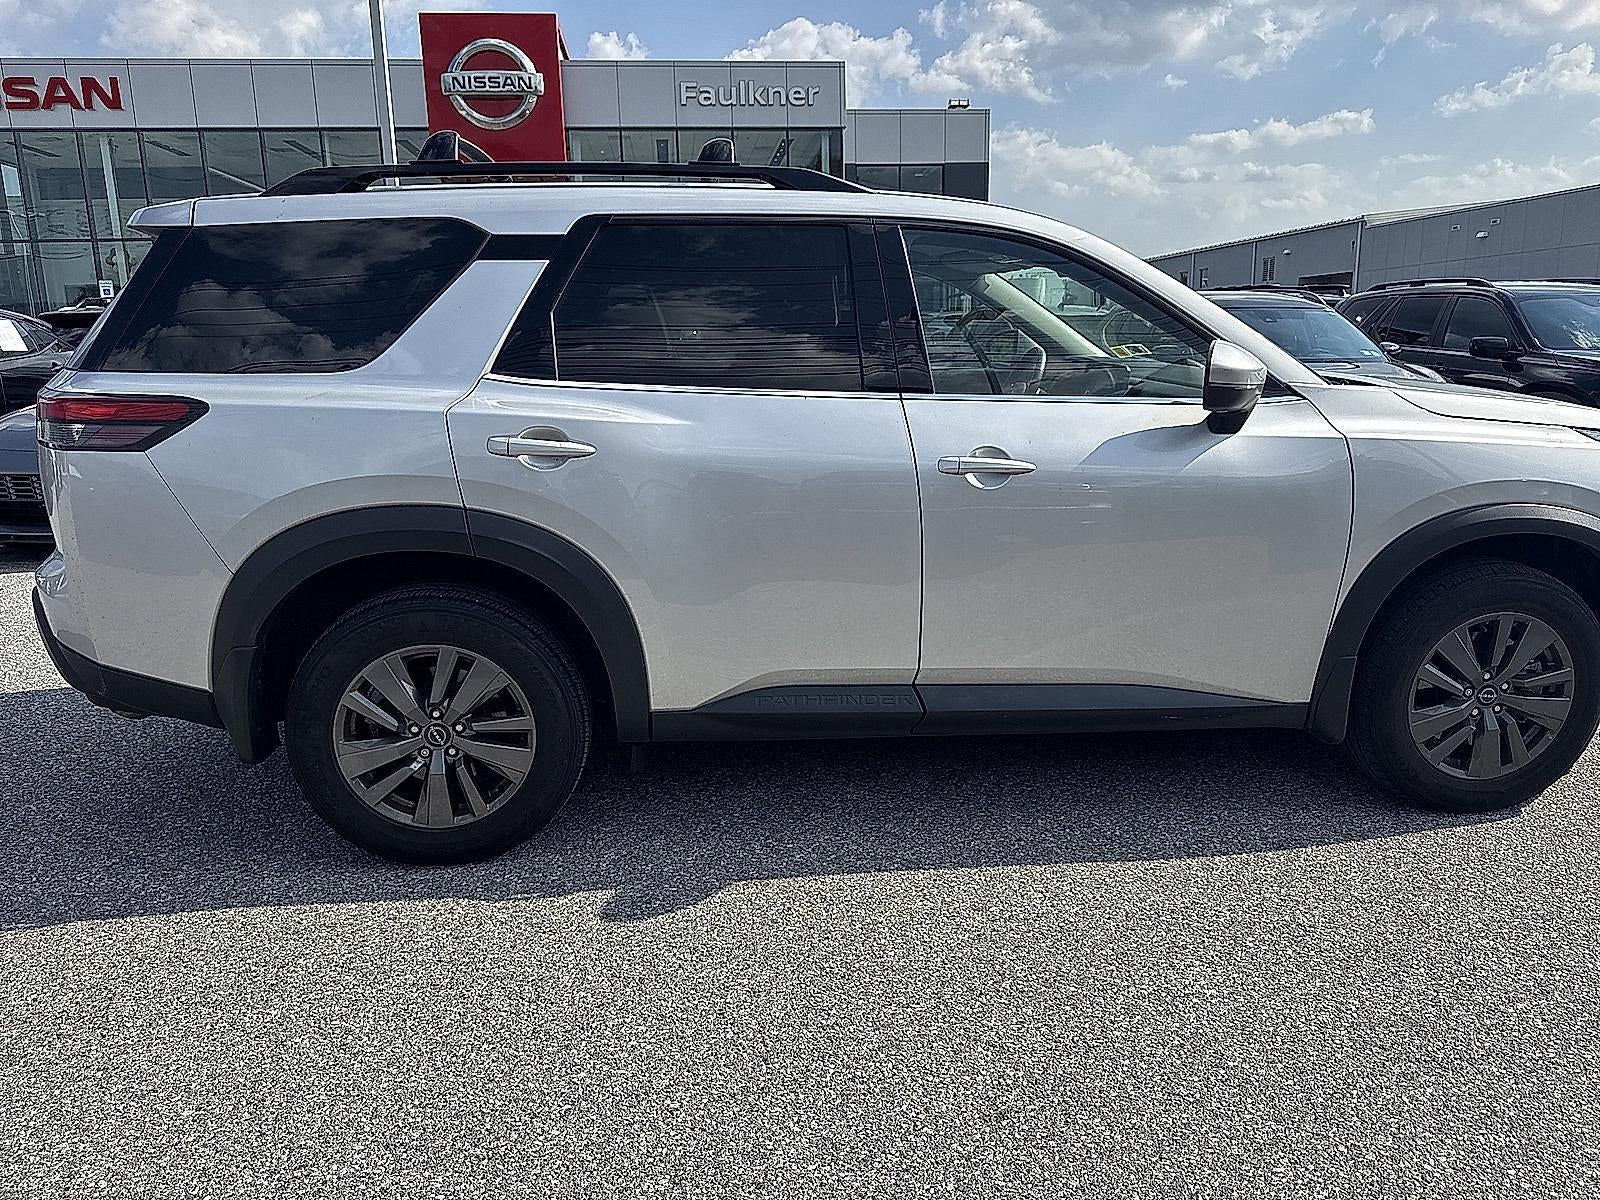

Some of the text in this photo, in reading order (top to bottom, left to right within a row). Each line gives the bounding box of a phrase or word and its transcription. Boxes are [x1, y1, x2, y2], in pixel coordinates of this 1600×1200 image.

[1, 76, 124, 111] SAN
[450, 75, 534, 91] NISSAN
[680, 80, 820, 106] Faulkner
[755, 693, 914, 706] PATHFINDER
